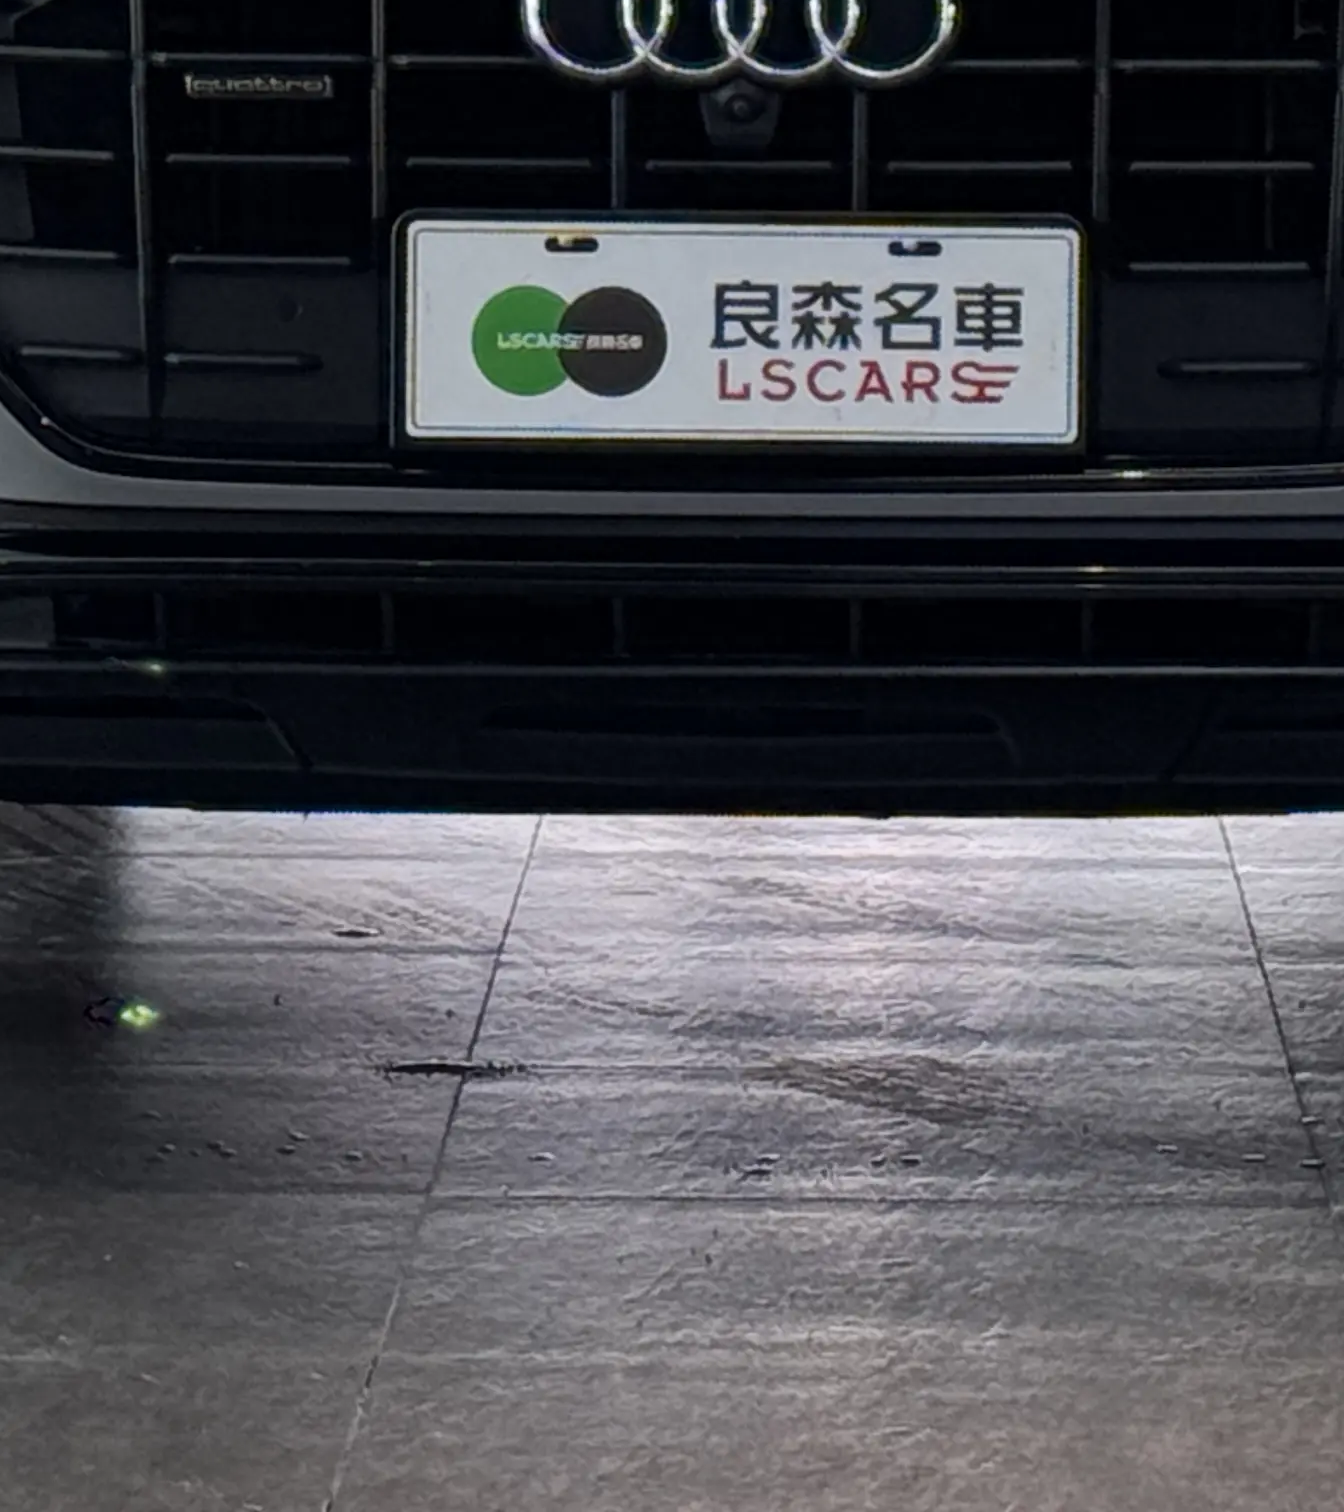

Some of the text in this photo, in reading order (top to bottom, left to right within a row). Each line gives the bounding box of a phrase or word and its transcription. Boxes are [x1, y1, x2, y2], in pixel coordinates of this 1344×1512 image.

[709, 279, 1024, 352] 良森名車
[717, 358, 1020, 404] LSCARS
